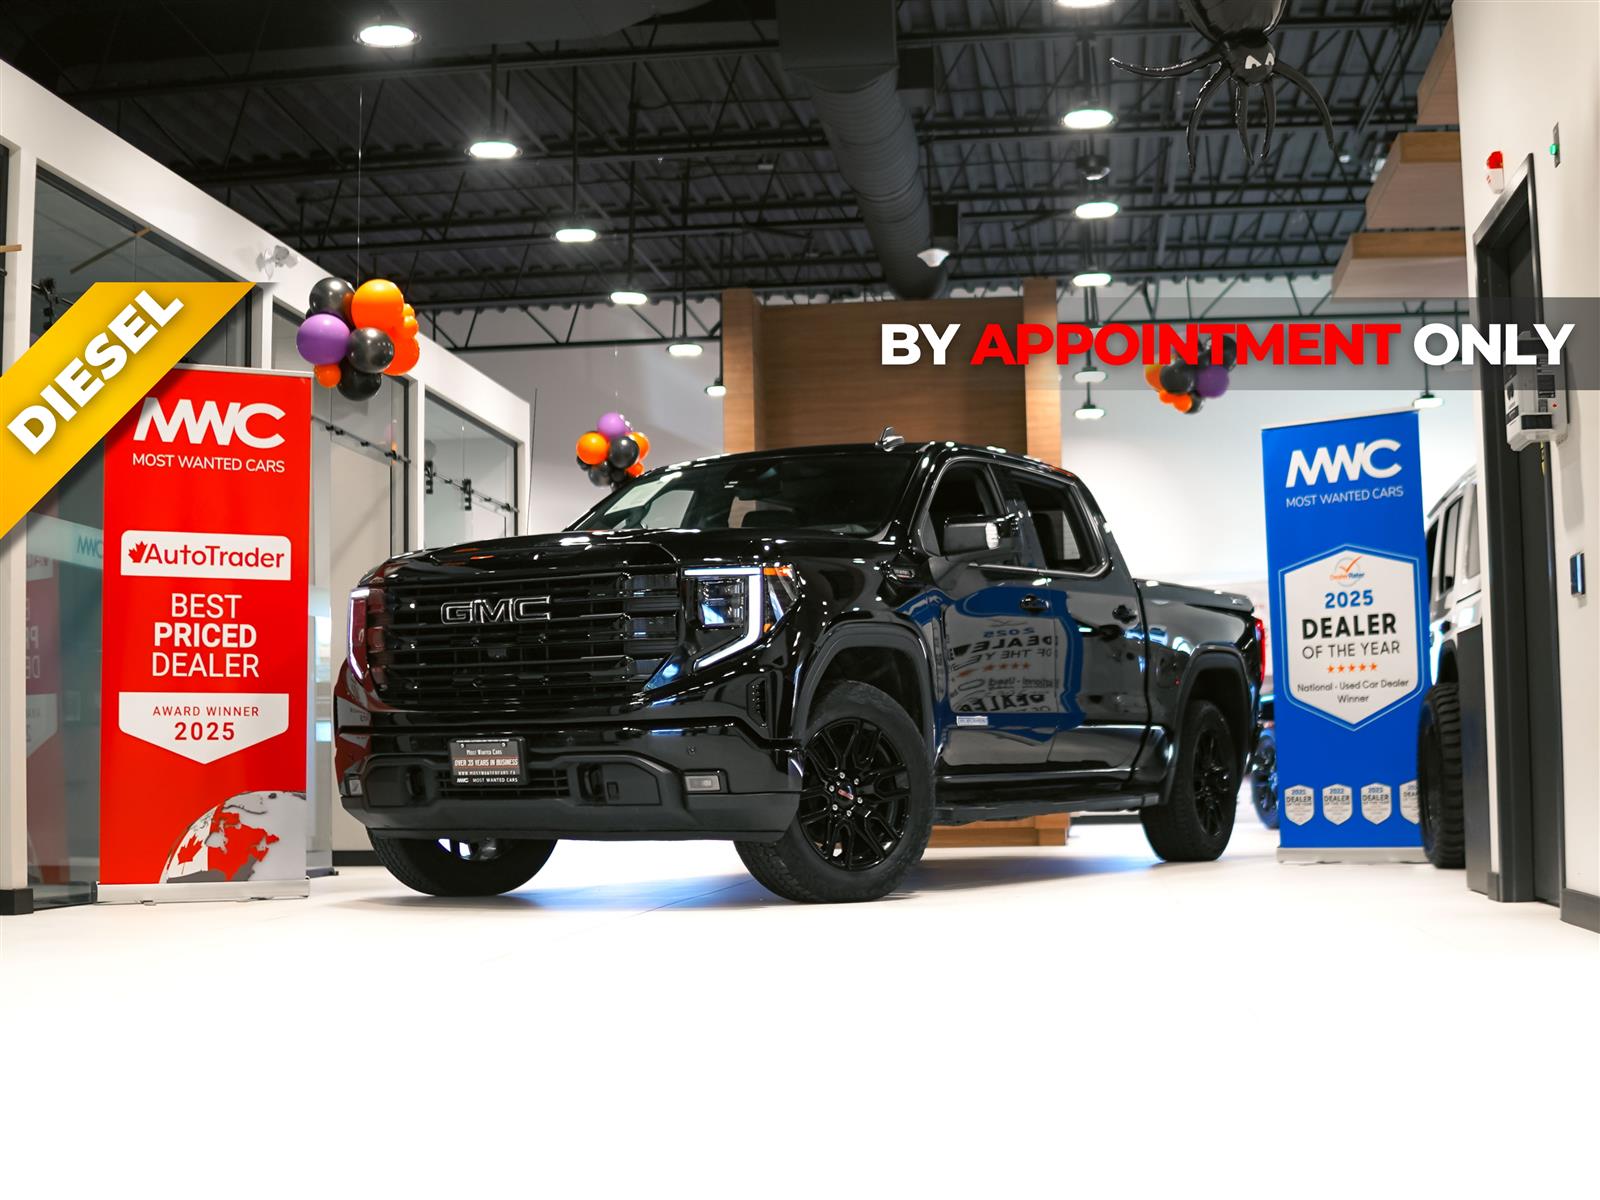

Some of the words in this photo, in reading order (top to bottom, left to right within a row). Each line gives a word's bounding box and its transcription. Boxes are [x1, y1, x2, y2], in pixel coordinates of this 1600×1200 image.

[132, 396, 287, 449] MWC
[132, 453, 175, 468] MOST
[178, 455, 242, 472] WANTED
[245, 458, 286, 474] CARS
[1285, 438, 1403, 489] MWC
[1286, 495, 1318, 508] MOST
[1320, 489, 1370, 505] WANTED
[1372, 486, 1404, 500] CARS
[144, 542, 285, 568] AutoTrader
[171, 593, 242, 619] BEST
[440, 595, 552, 625] GMC
[1324, 589, 1374, 609] 2025
[154, 621, 257, 649] PRICED
[1302, 613, 1396, 639] DEALER
[1302, 645, 1323, 659] OF
[1327, 642, 1355, 657] THE
[1360, 640, 1400, 655] YEAR
[151, 651, 259, 678] DEALER
[1297, 682, 1332, 692] National
[1340, 680, 1362, 690] Used
[1363, 680, 1379, 689] Car
[1381, 678, 1409, 688] Dealer
[1337, 694, 1369, 703] Winner
[153, 706, 200, 717] AWARD
[206, 706, 259, 717] WINNER
[174, 721, 235, 741] 2025
[496, 758, 518, 766] BUSINESS
